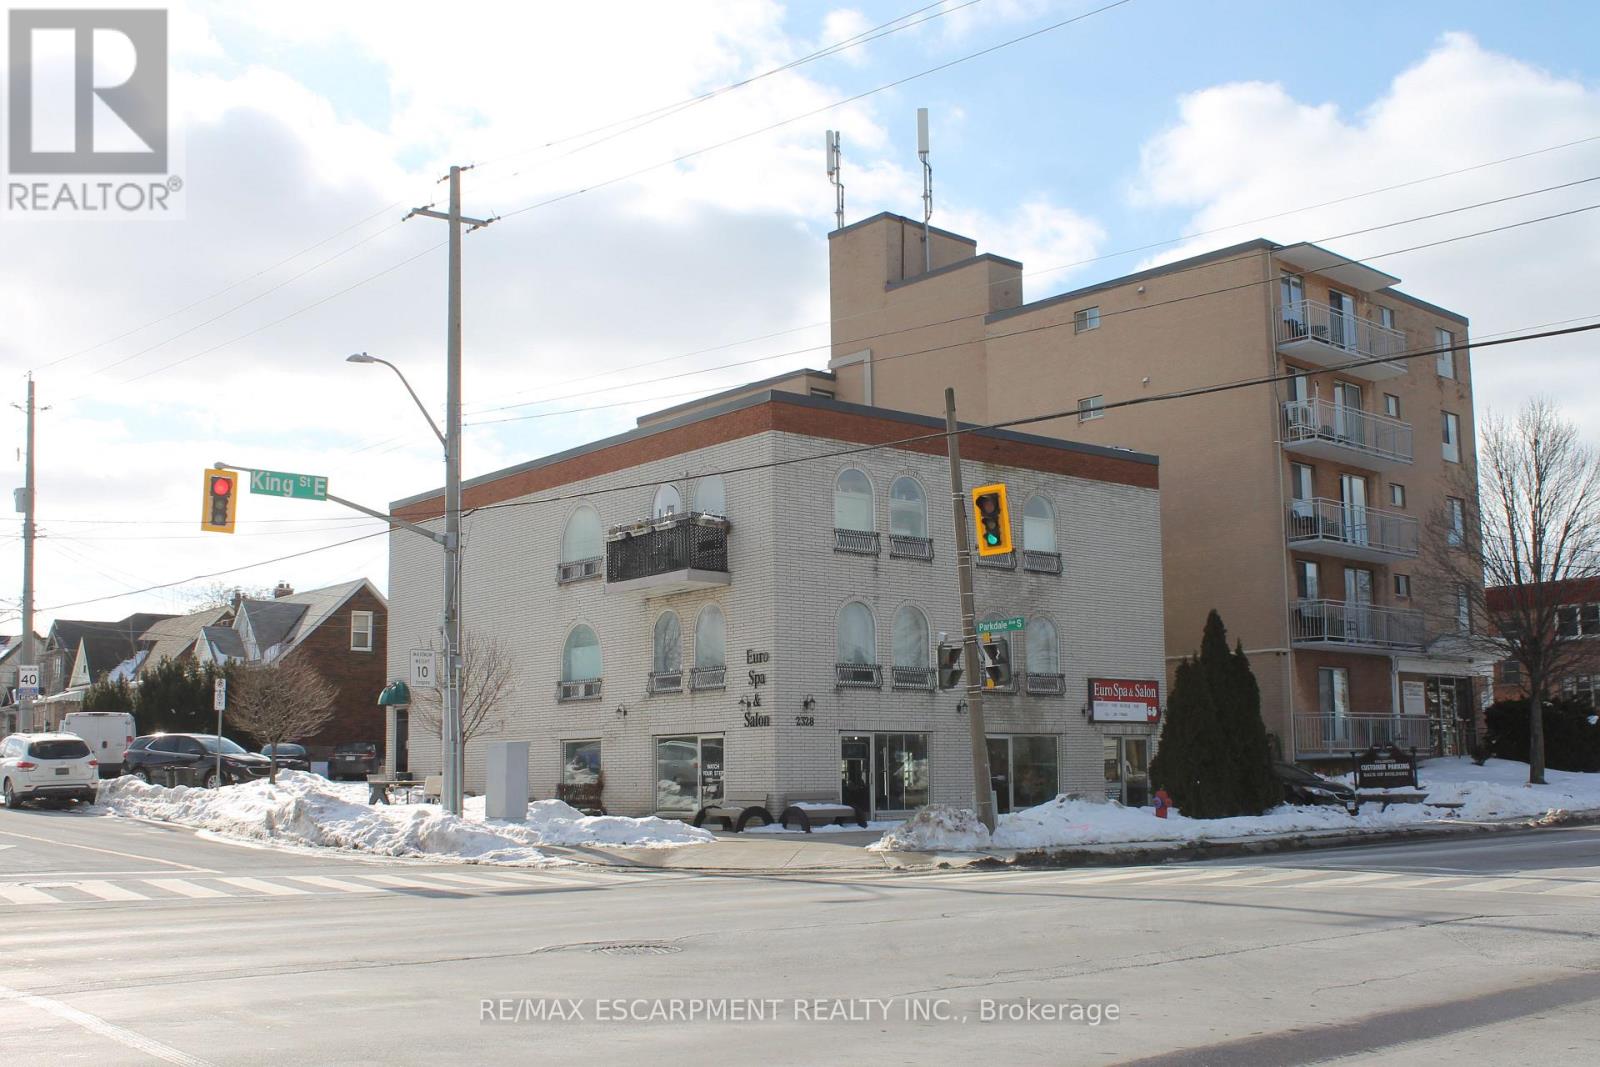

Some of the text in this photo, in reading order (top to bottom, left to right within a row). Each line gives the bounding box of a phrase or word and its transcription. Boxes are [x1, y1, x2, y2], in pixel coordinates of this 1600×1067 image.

[251, 470, 327, 498] King St E
[978, 620, 1008, 632] Parkdale
[1016, 618, 1022, 628] S
[746, 649, 769, 664] Euro
[417, 666, 428, 678] 10
[21, 674, 37, 685] 40
[748, 670, 766, 689] Spa
[1094, 682, 1157, 700] Euro Spa & Salon
[753, 693, 761, 707] &
[744, 712, 770, 728] Salon
[796, 716, 815, 726] 2328
